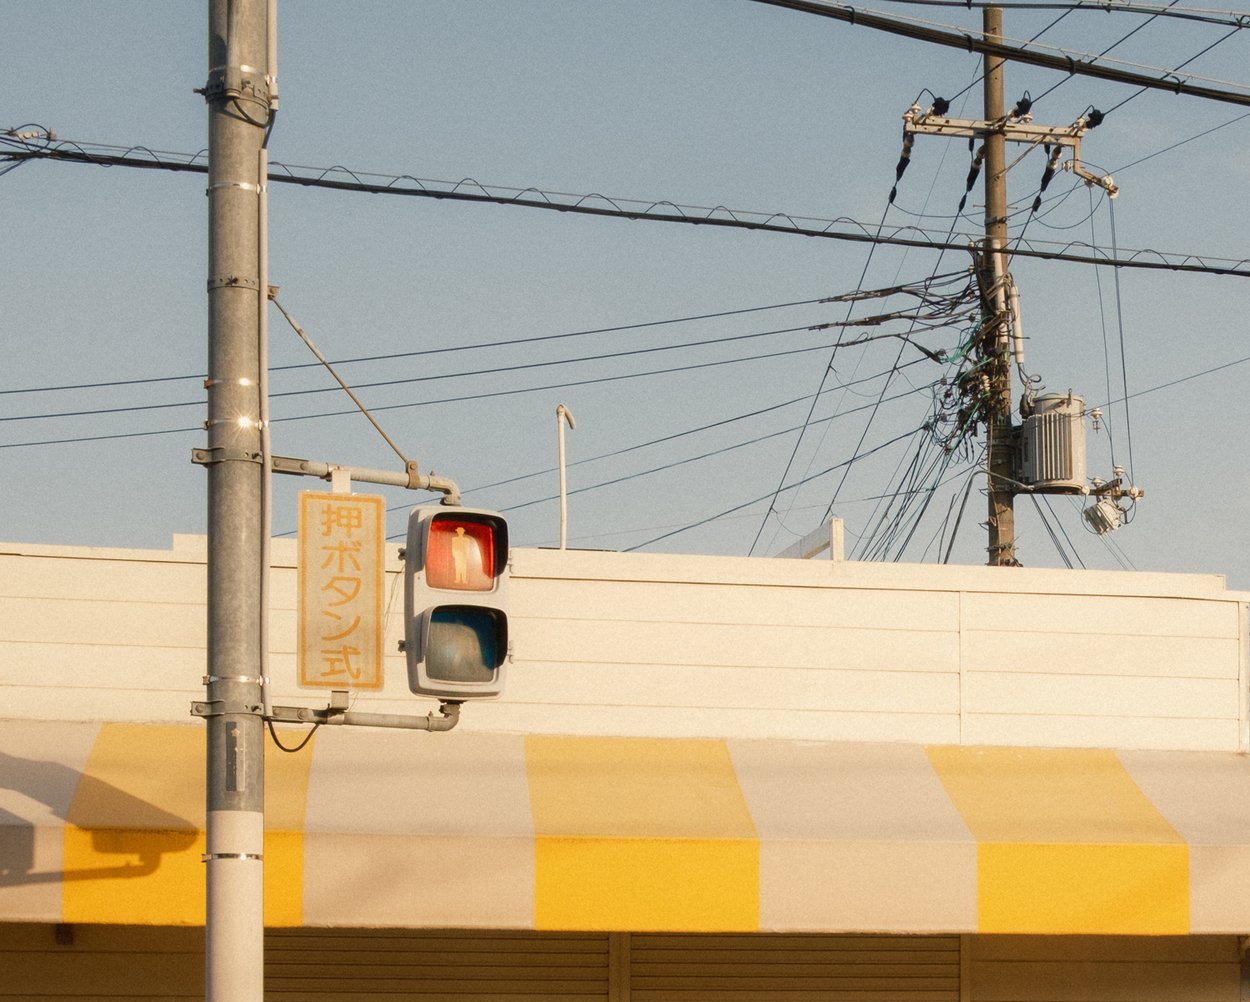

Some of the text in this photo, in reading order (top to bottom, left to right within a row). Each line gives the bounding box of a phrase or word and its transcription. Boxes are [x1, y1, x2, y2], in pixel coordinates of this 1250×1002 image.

[320, 503, 363, 680] 押ボタン式
